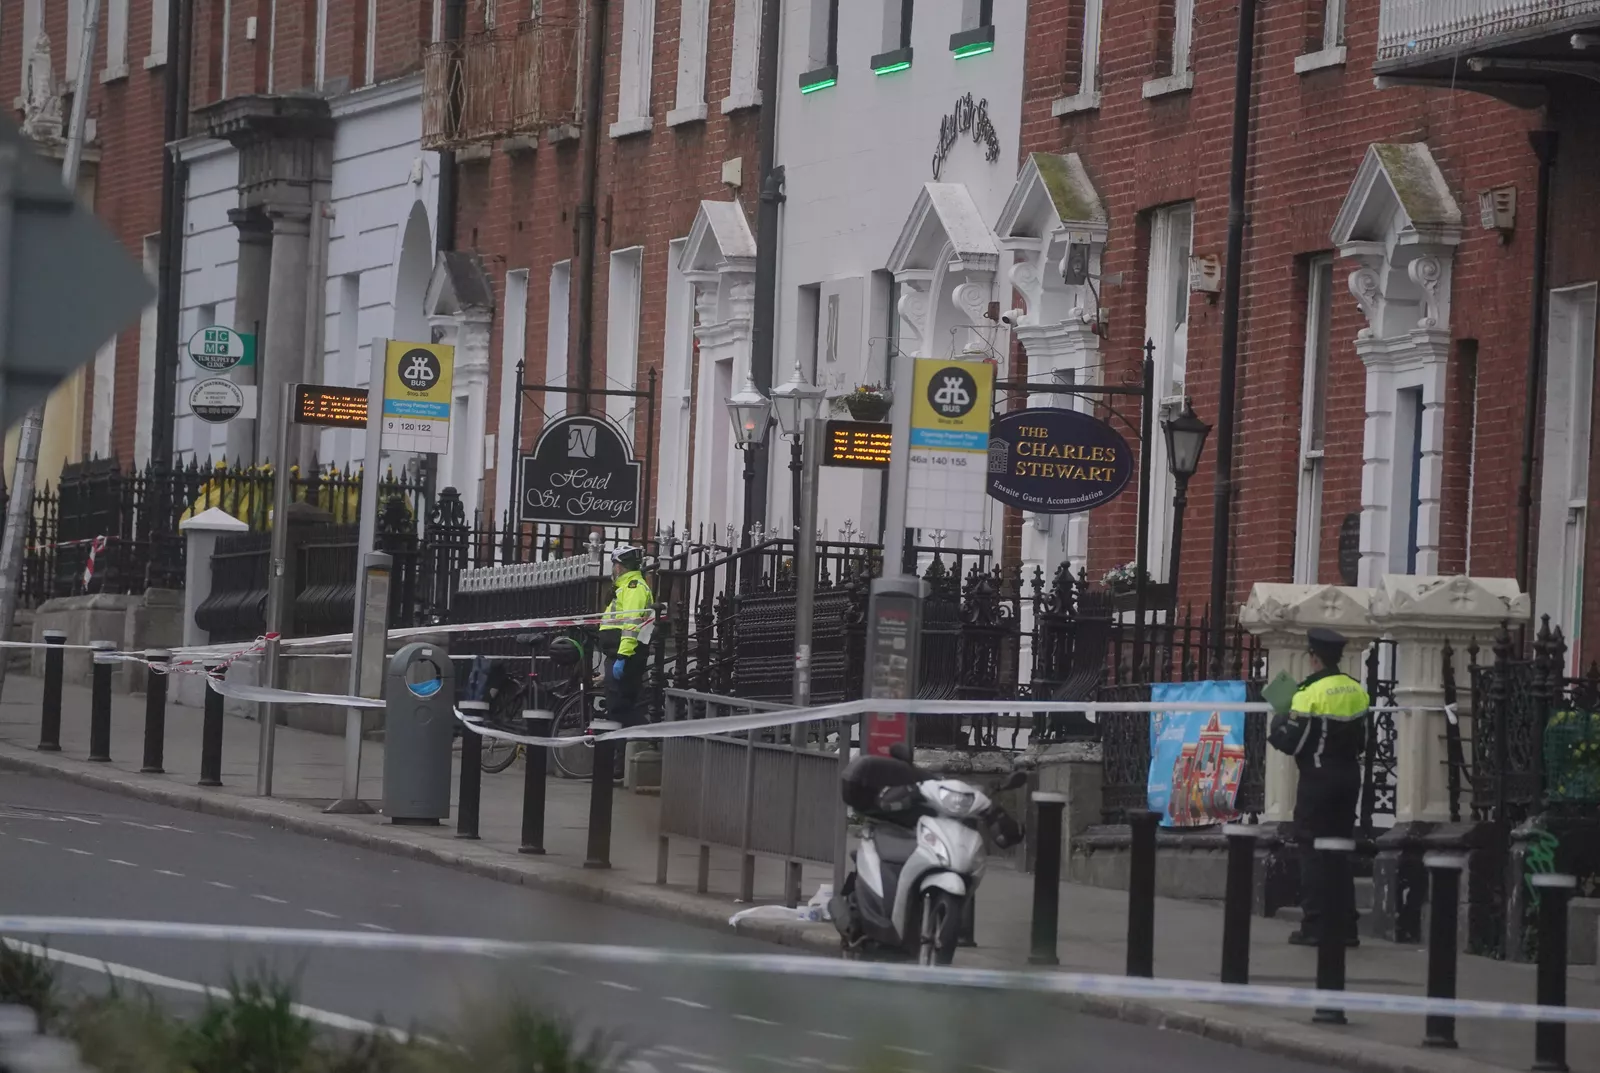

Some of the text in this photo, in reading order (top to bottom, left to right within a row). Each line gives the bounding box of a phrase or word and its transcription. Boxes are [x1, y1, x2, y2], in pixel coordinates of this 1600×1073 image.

[942, 404, 960, 412] BUS
[1019, 426, 1048, 438] THE
[951, 458, 967, 466] 155
[1016, 441, 1116, 462] CHARLES
[550, 468, 612, 489] Hotel
[1015, 460, 1115, 482] STEWART
[993, 480, 1104, 504] Ensuite Guest Accommodation
[526, 488, 633, 518] St. George
[1326, 686, 1357, 695] GARDA
